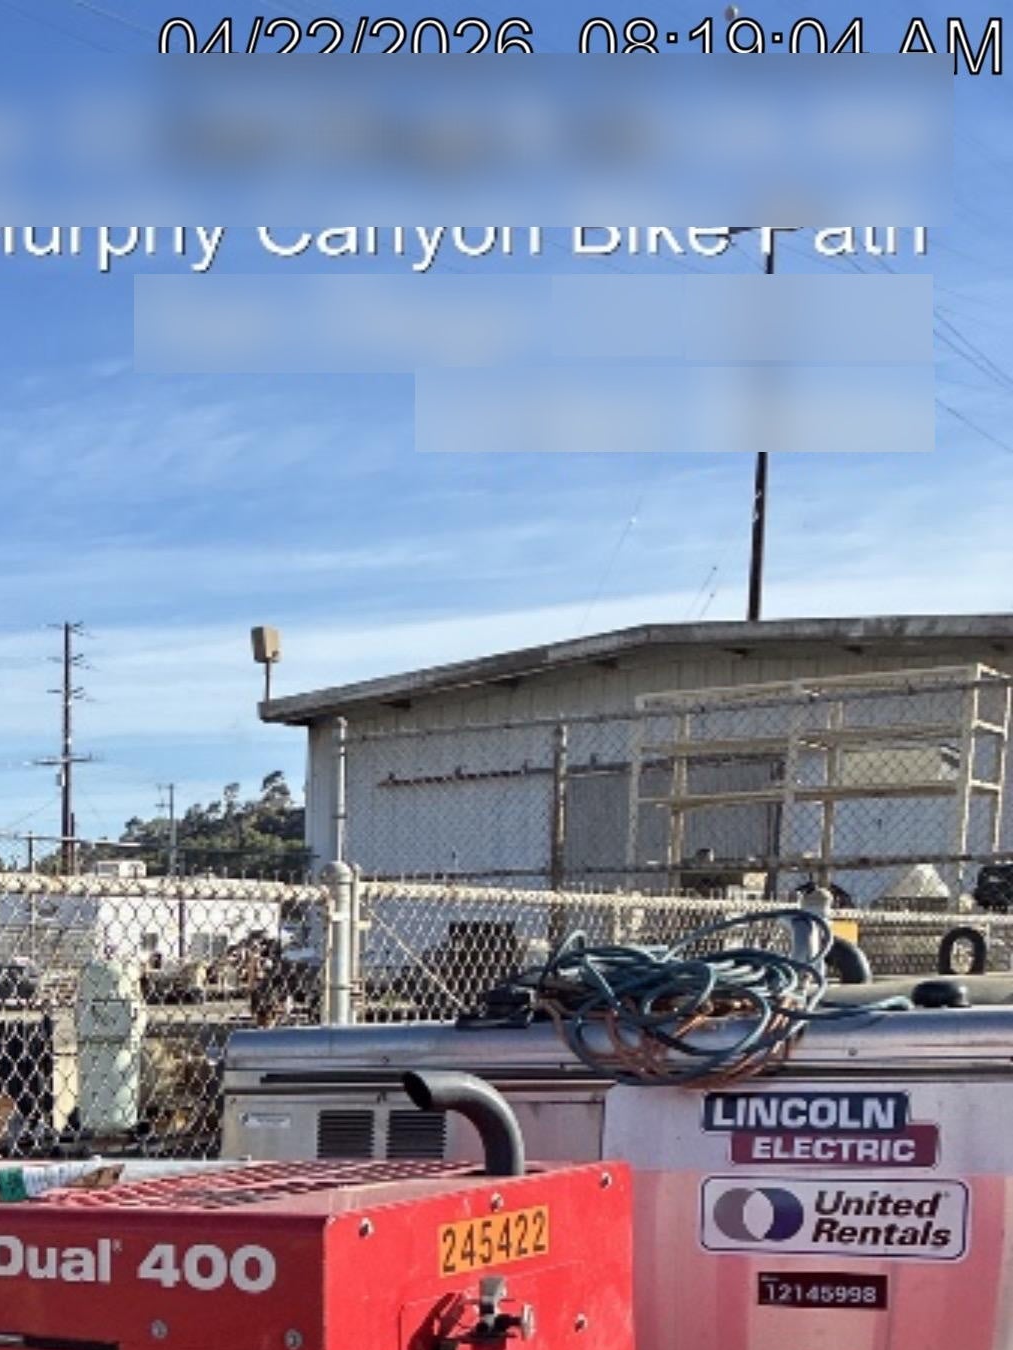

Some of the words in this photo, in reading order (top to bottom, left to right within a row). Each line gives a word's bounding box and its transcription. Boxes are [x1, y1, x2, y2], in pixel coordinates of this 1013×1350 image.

[712, 1097, 895, 1129] LINCOLN
[752, 1137, 916, 1162] ELECTRIC
[815, 1190, 942, 1219] United
[441, 1210, 547, 1274] 245422
[811, 1218, 951, 1248] Rentals
[138, 1243, 277, 1294] 400
[765, 1283, 877, 1304] 12145998
